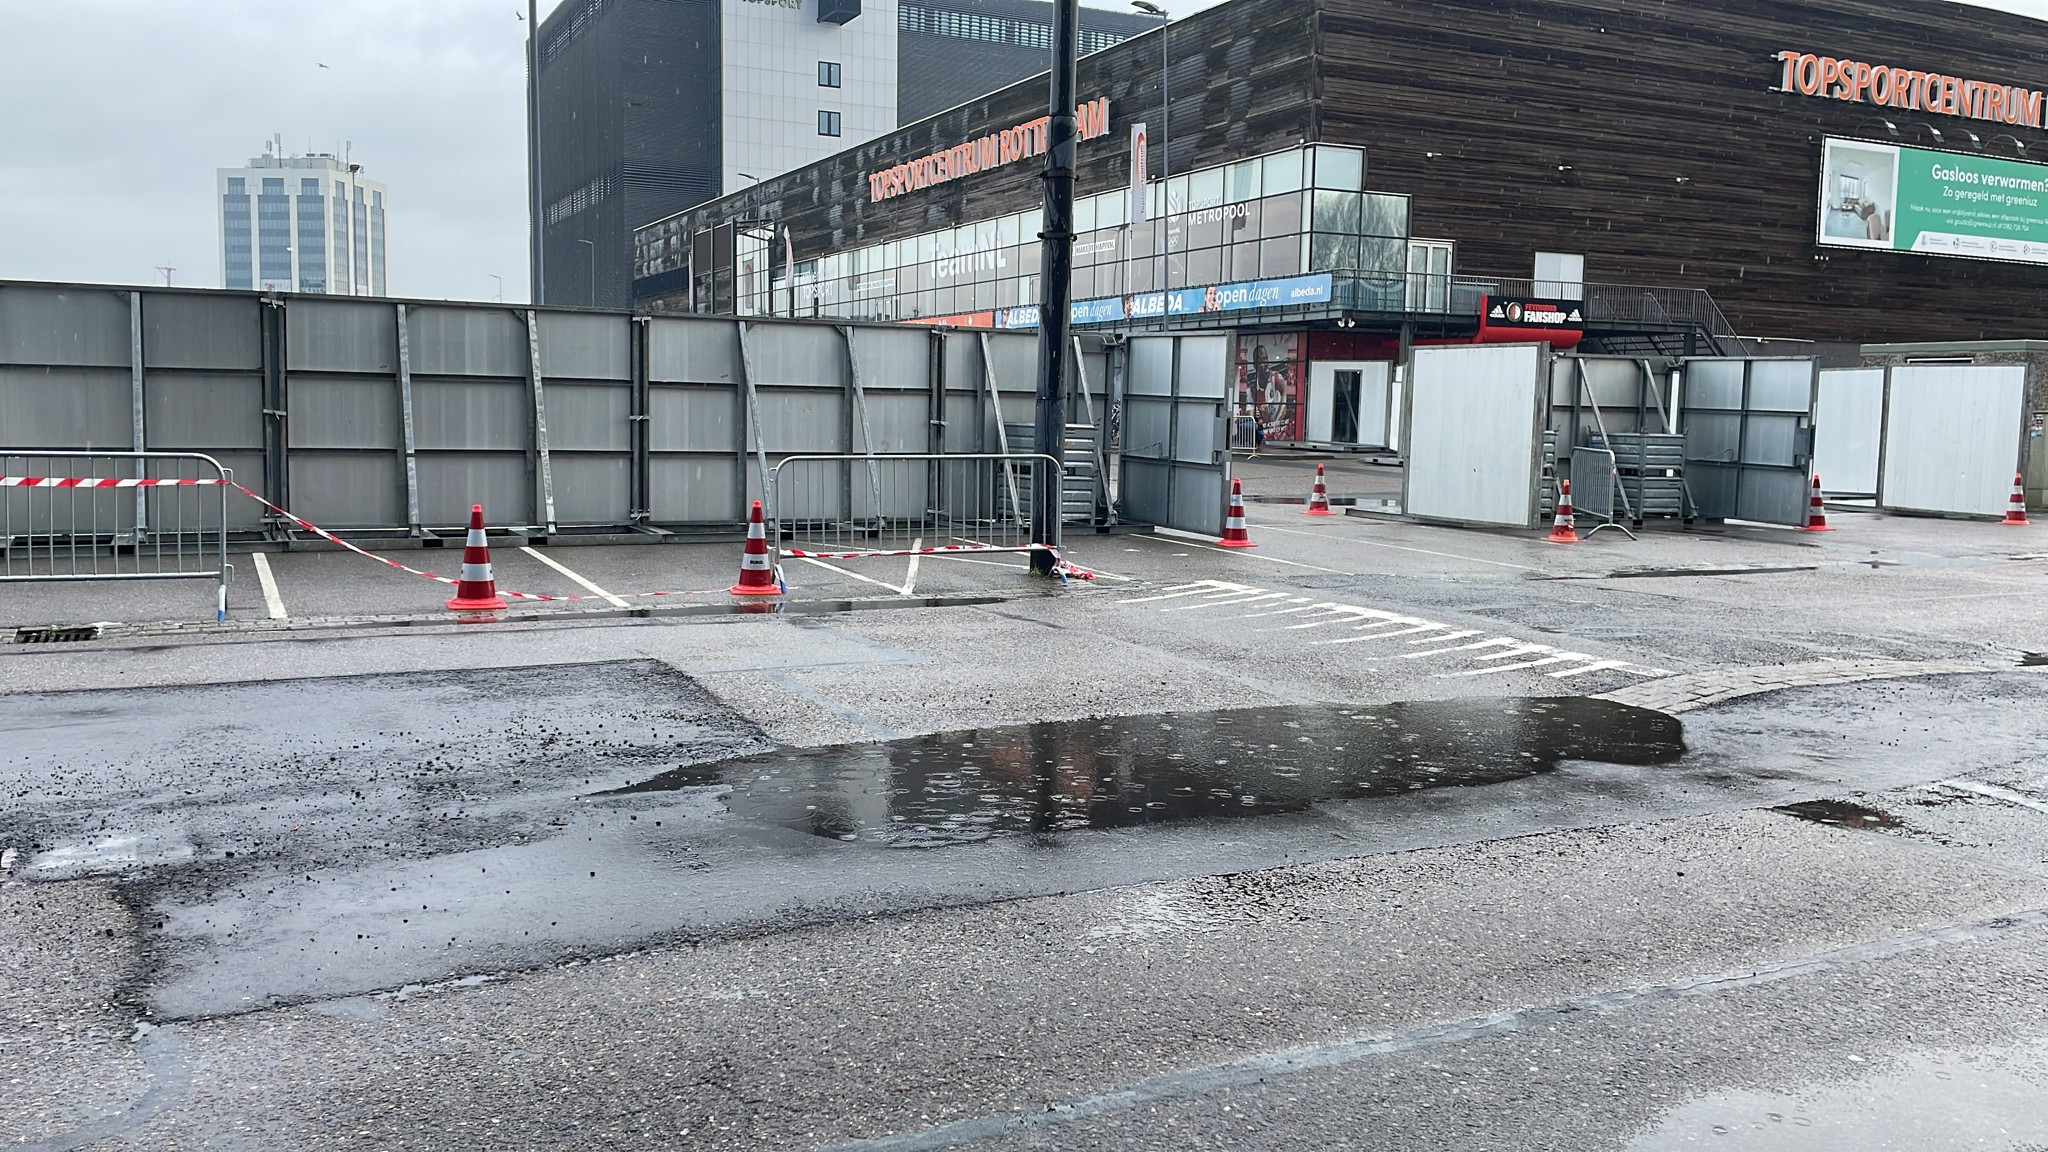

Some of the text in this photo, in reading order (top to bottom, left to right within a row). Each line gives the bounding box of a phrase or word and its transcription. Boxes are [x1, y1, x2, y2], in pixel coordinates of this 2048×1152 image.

[1779, 51, 2042, 128] TOPSPORTCENTRUM
[869, 97, 1110, 203] TOPSPORTCENTRUM ROTTEAM
[1931, 164, 2048, 193] Gasloos verwarmen?
[1188, 195, 1221, 210] TOPSPORT
[1943, 186, 2039, 207] Zo geregeld met greeniuz
[1188, 202, 1251, 227] METROPOOL
[929, 230, 1007, 280] TeamNL
[1131, 293, 1183, 315] ALBEDA
[1216, 283, 1324, 306] open dagen albeda.nl
[1007, 308, 1040, 327] ALBED
[1071, 301, 1113, 321] pen dagen
[1523, 311, 1567, 324] FANSHOP
